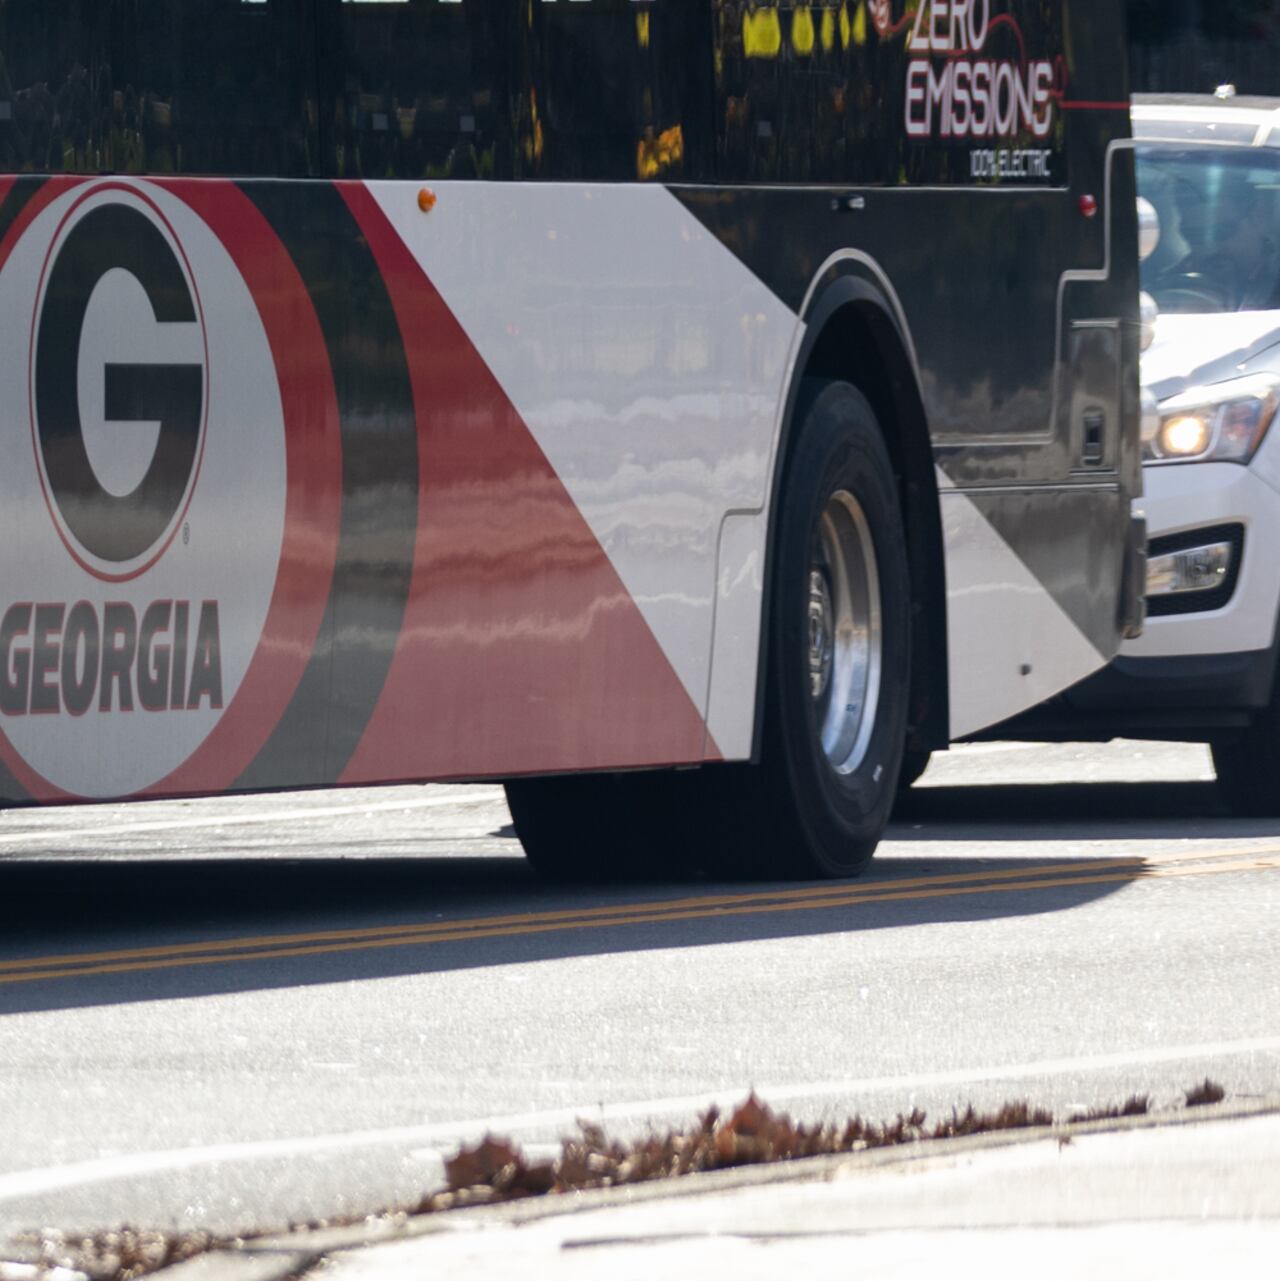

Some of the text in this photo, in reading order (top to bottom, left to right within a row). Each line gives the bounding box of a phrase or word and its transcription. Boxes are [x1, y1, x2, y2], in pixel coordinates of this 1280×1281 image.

[904, 57, 1053, 137] EMISSIONS
[999, 149, 1052, 177] ELECTRIC
[35, 201, 203, 562] G
